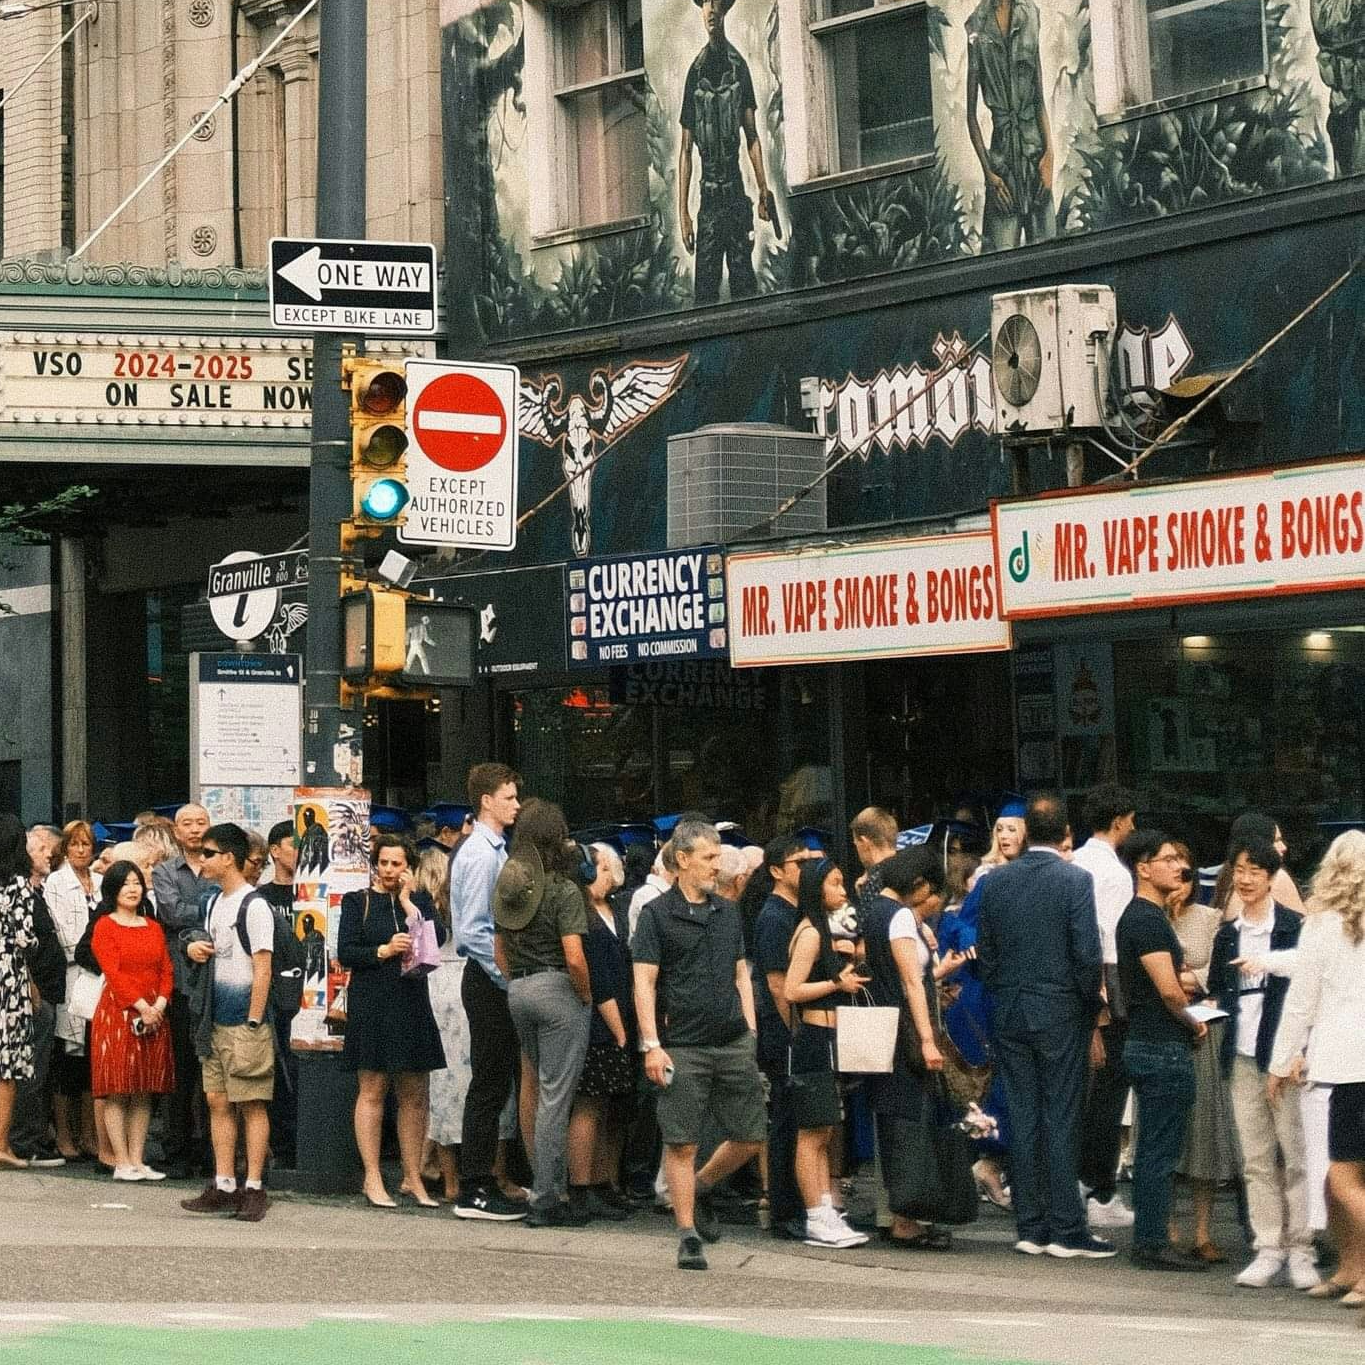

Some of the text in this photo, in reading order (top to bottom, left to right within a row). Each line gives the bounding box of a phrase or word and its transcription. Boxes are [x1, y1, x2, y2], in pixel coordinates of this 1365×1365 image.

[317, 263, 424, 288] ONE WAY
[284, 308, 423, 326] EXCEPT BIKE LANE
[34, 351, 83, 376] VSO
[113, 352, 254, 380] 2024-2025
[105, 382, 138, 407] ON
[169, 383, 233, 409] SALE
[429, 477, 487, 496] EXCEPT
[409, 496, 505, 517] AUTHORIZED
[420, 516, 495, 537] VEHICLES
[1054, 521, 1096, 583] MR.
[1103, 515, 1159, 576] VAPE
[1166, 505, 1245, 572] SMOKE
[1255, 502, 1274, 564] &
[1281, 490, 1365, 560] BONGS
[212, 562, 272, 594] Granville
[587, 553, 705, 602] CURRENCY
[741, 564, 995, 638] MR. VAPE SMOKE & BONGS
[590, 592, 706, 639] EXCHANGE
[599, 637, 698, 660] NO FEES NO COMMISSION
